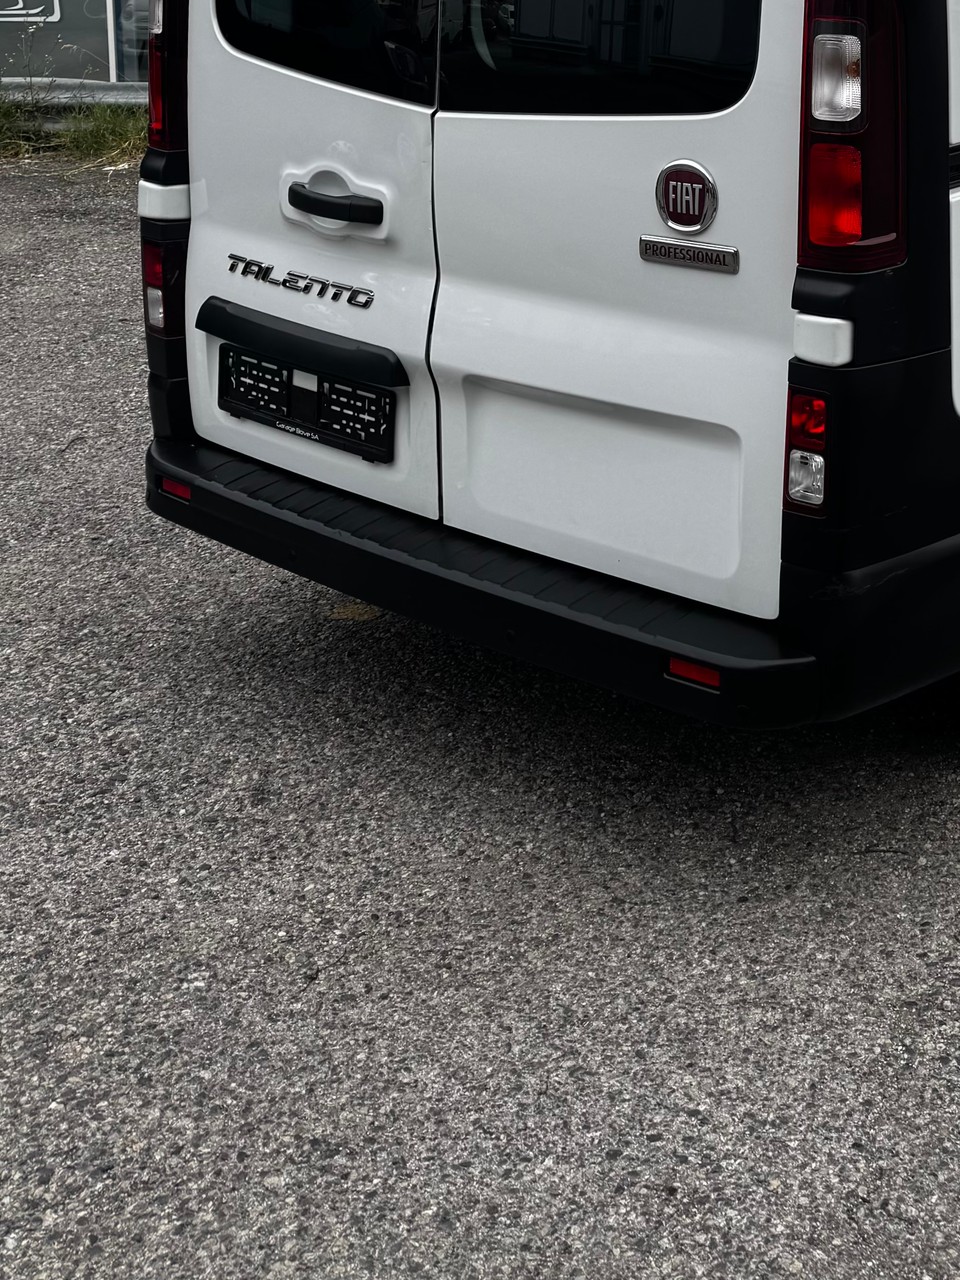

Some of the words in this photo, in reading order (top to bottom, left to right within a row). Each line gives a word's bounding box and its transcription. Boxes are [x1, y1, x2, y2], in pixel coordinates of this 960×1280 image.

[669, 181, 702, 215] FIAT
[644, 243, 729, 266] PROFESSIONAL
[227, 253, 375, 309] TALENTO
